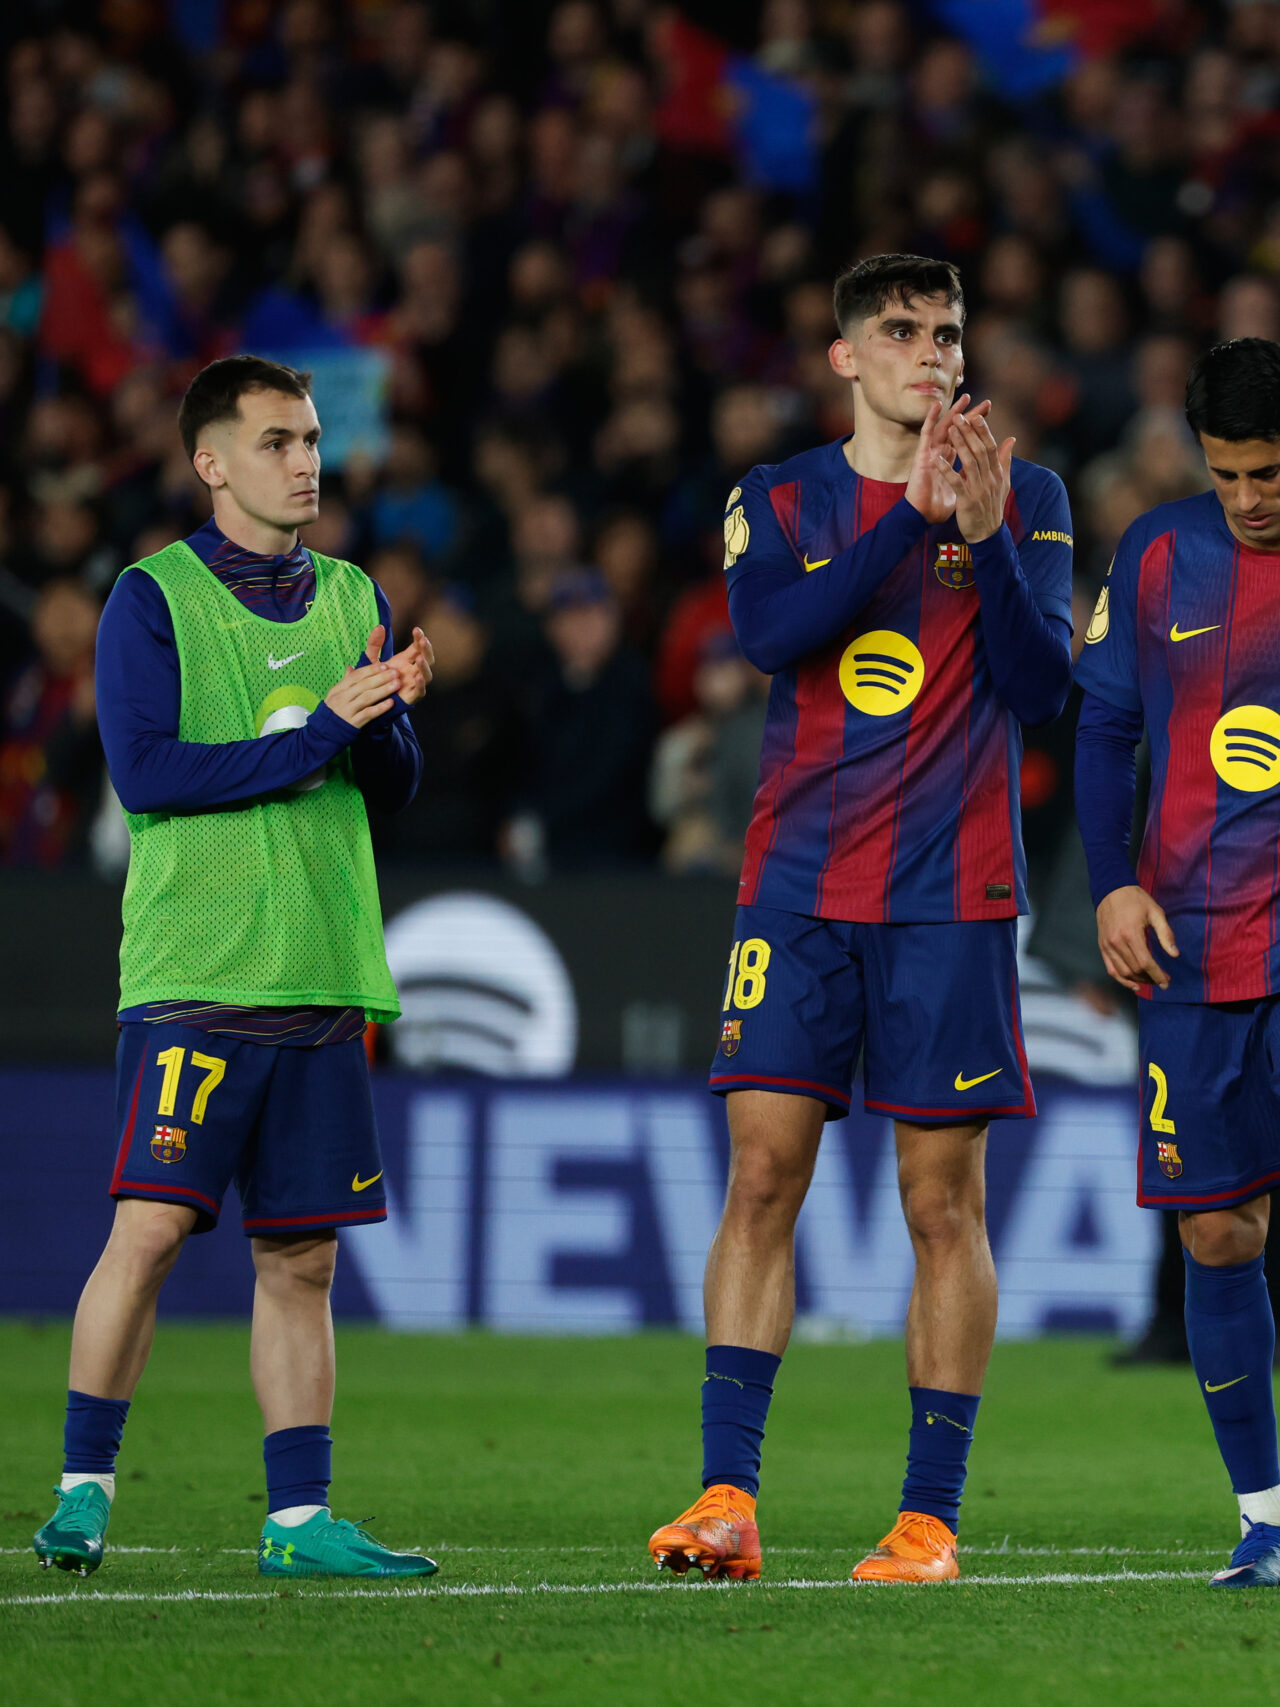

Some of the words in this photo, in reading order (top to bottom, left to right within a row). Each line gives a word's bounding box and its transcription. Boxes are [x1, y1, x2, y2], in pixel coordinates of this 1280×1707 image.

[722, 938, 772, 1012] 18
[156, 1046, 227, 1126] 17
[1148, 1062, 1176, 1135] 2
[346, 1089, 918, 1340] NEW
